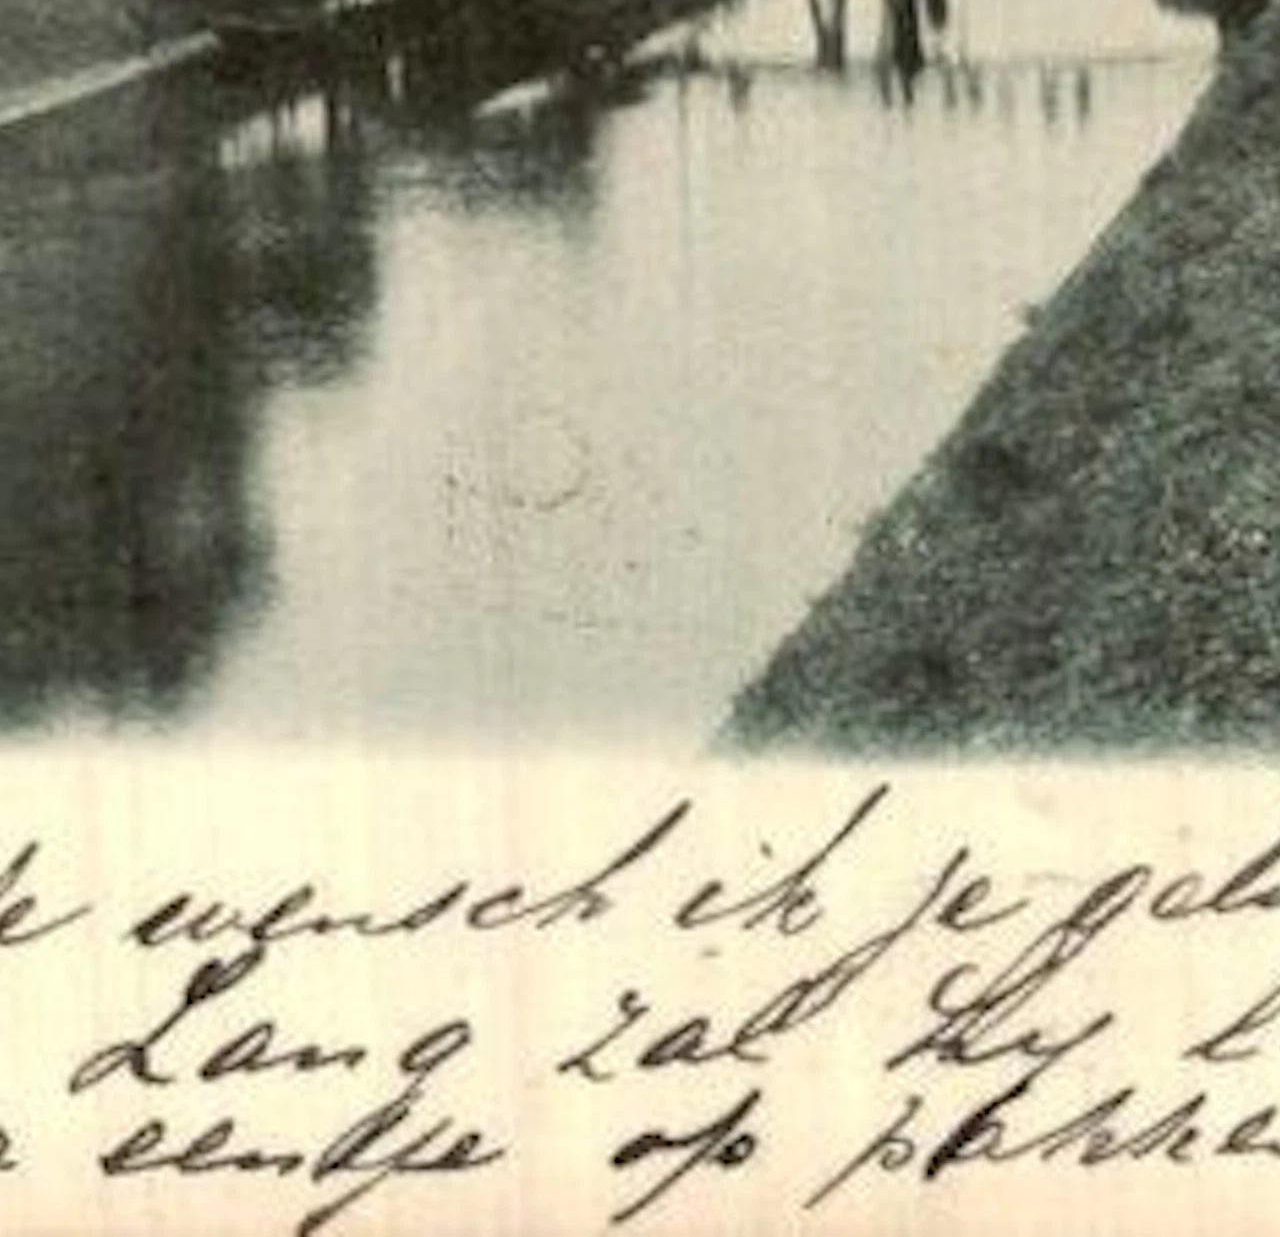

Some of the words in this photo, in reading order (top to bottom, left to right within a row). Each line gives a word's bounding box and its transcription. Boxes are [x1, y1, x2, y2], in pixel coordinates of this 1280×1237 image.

[120, 799, 692, 949] wensch
[672, 781, 890, 937] ik
[68, 945, 473, 1108] Lang
